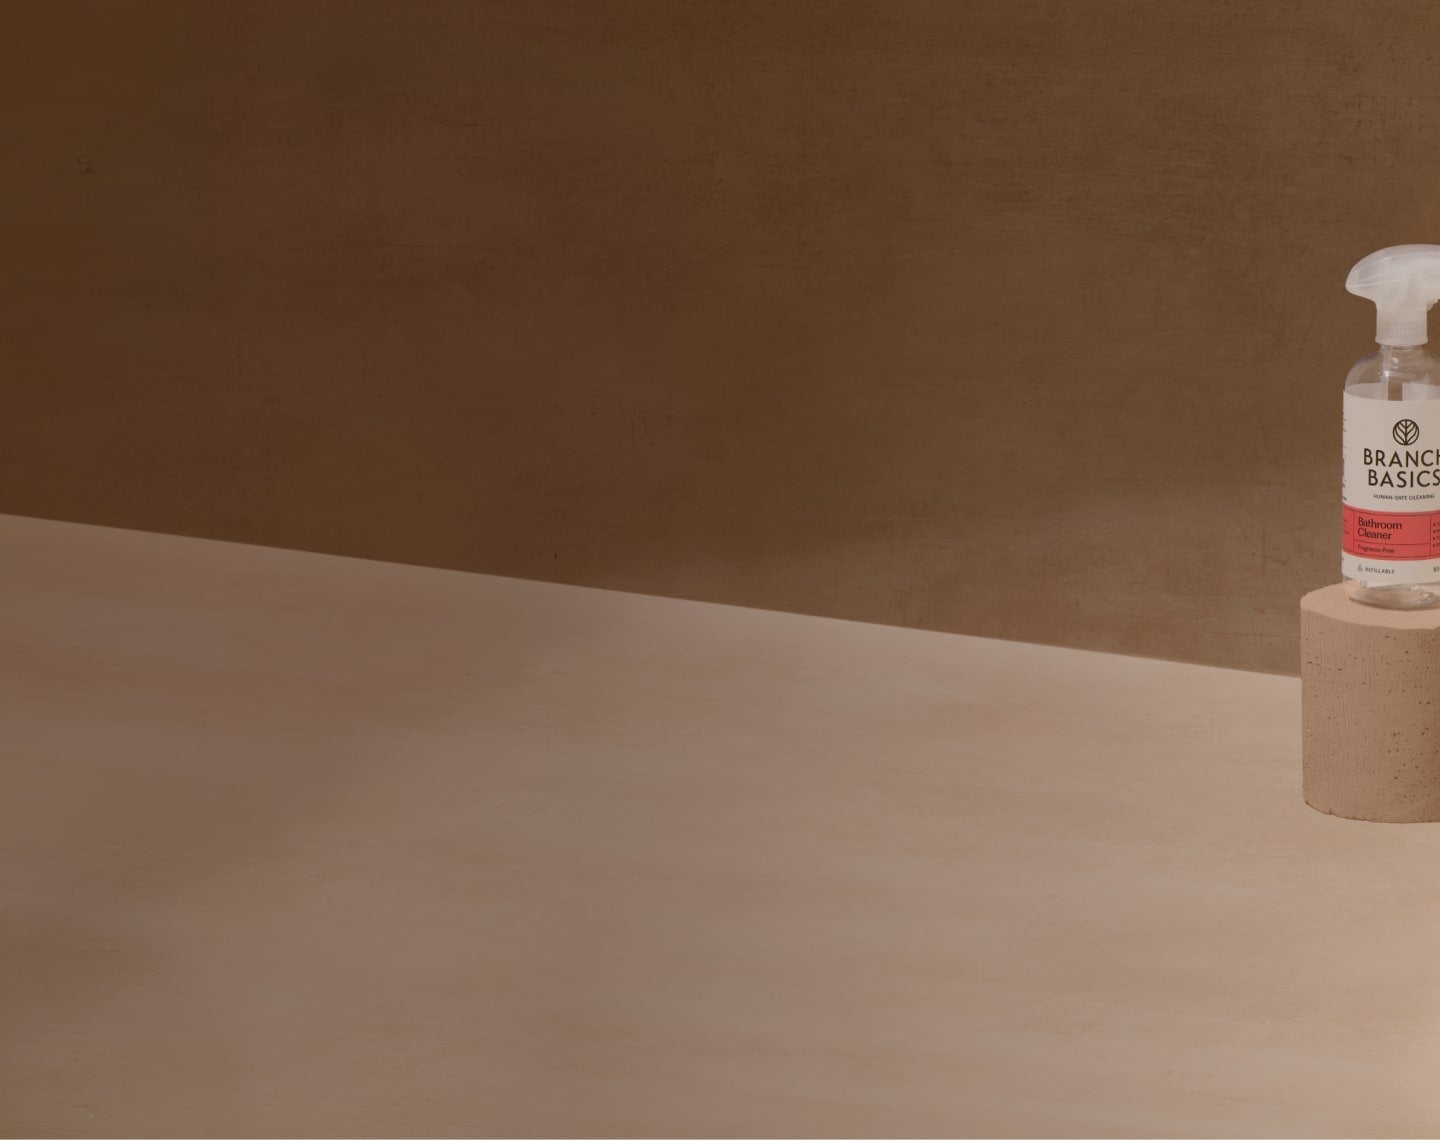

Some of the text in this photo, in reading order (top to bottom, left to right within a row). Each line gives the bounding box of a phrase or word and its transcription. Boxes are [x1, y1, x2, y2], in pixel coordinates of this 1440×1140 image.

[1368, 468, 1440, 488] BASICS
[1358, 517, 1402, 530] Bathroom
[1357, 527, 1392, 540] Cleaner
